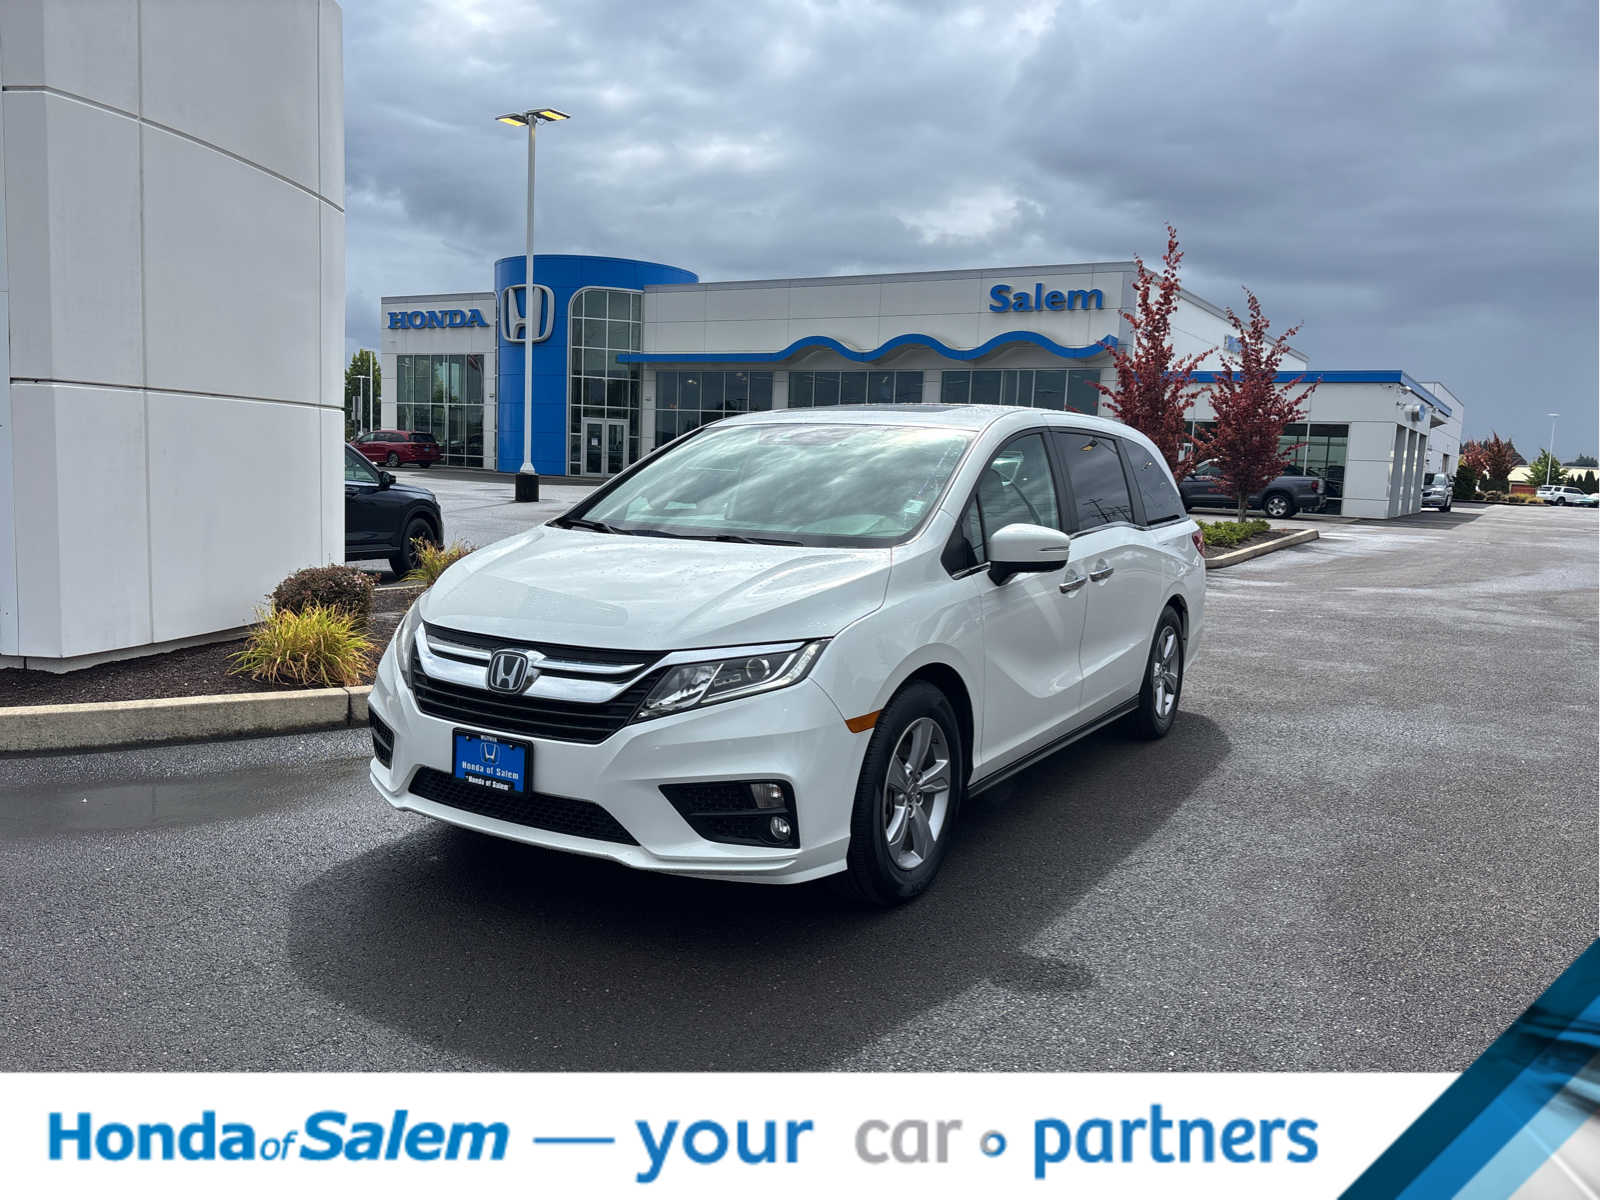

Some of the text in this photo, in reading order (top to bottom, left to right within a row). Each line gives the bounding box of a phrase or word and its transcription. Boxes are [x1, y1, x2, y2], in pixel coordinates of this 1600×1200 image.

[989, 283, 1103, 312] Salem
[388, 308, 488, 329] HONDA
[462, 761, 519, 780] Honda of Salem
[492, 781, 509, 791] Salem
